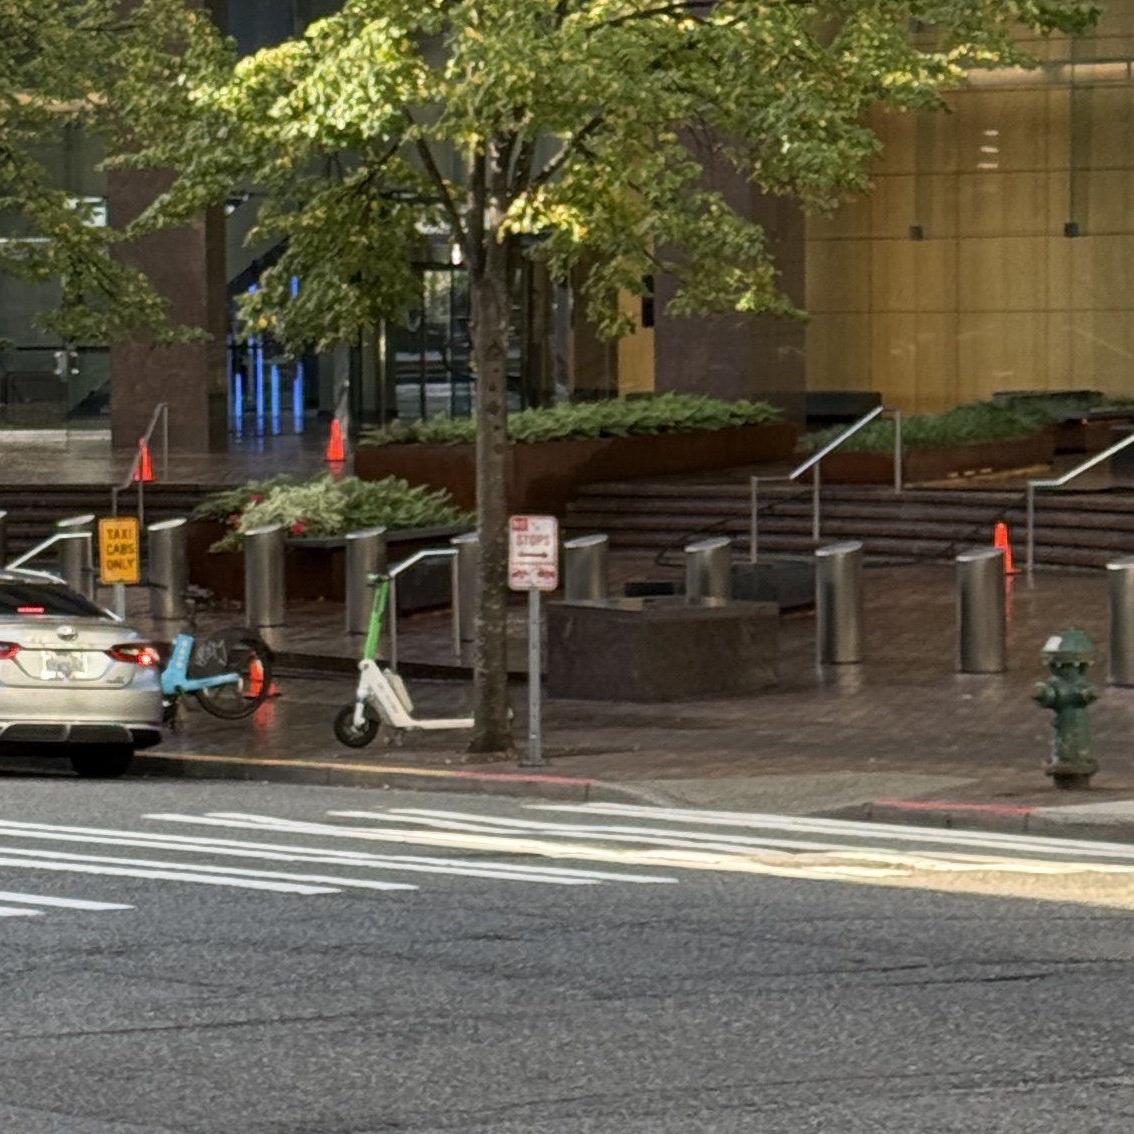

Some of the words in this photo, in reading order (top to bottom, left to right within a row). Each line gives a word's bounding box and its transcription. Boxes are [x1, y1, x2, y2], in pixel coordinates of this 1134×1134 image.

[106, 529, 133, 540] TAXI
[106, 543, 135, 556] CABS
[106, 558, 135, 571] ONLY
